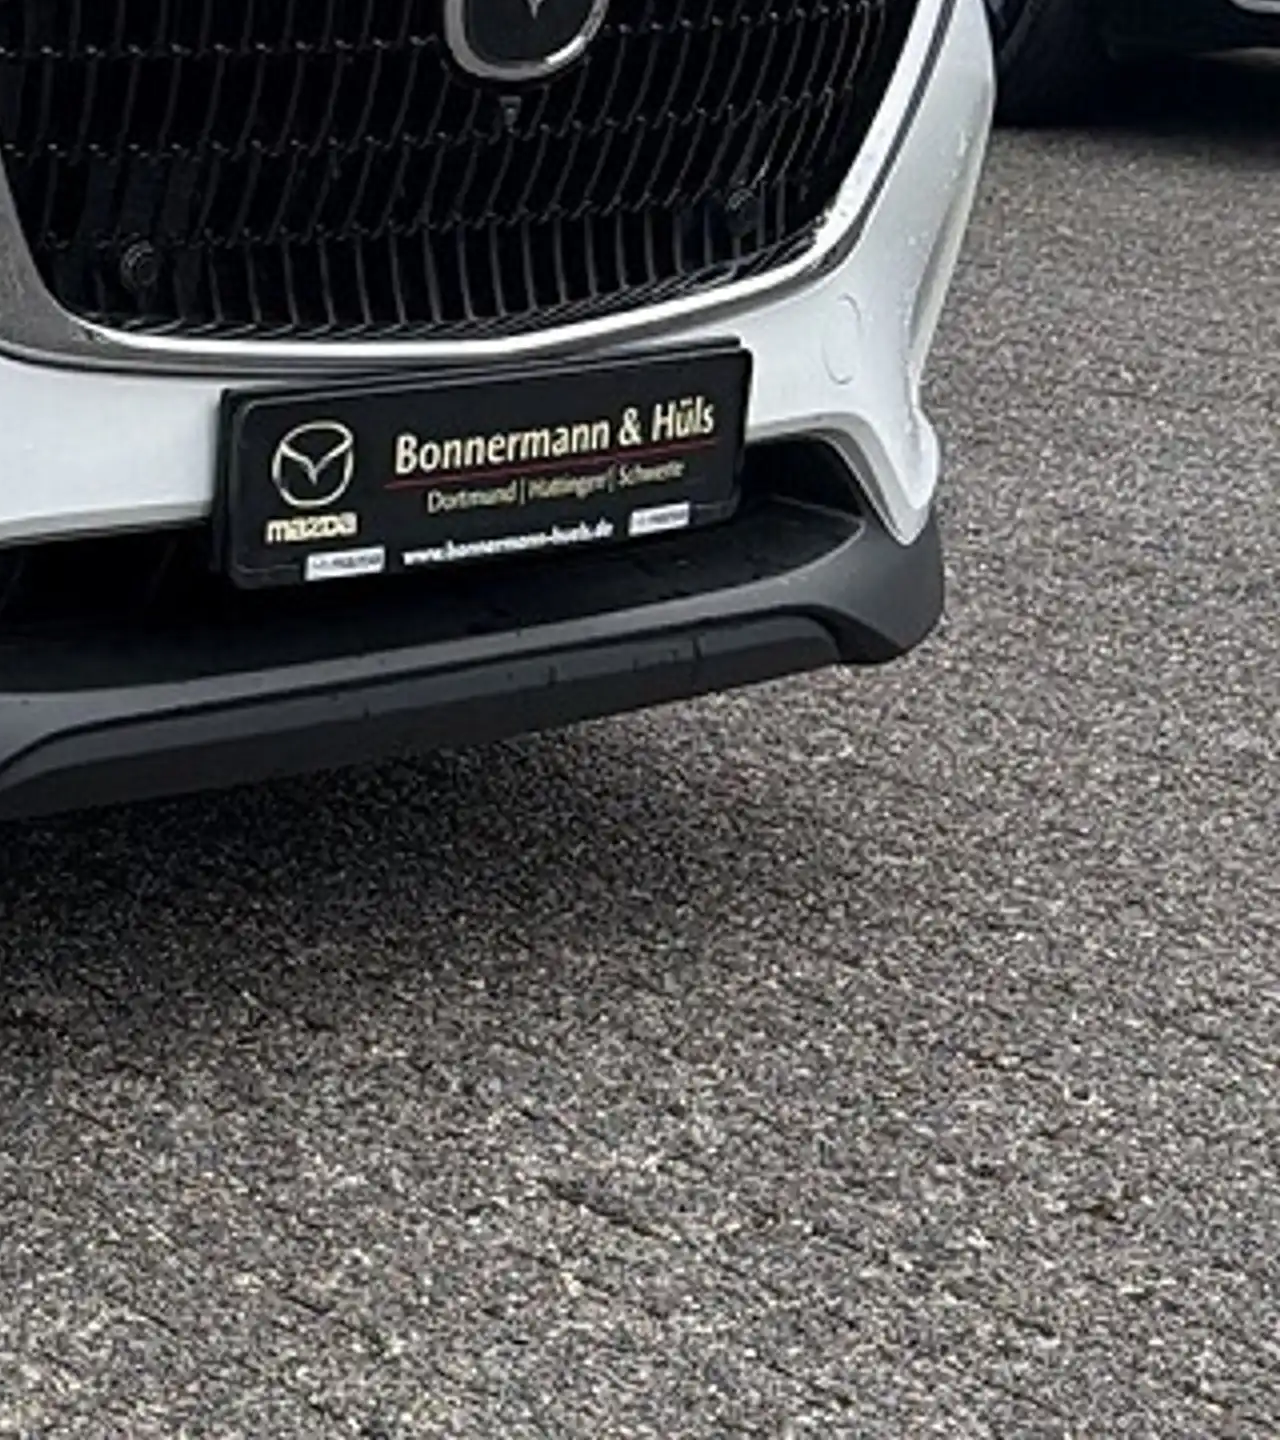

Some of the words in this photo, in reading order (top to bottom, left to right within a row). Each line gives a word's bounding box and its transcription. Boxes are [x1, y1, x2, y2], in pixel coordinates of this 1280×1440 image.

[395, 419, 611, 475] Bonnermann
[618, 408, 642, 447] &
[651, 395, 715, 443] Hüls
[426, 479, 518, 513] Dortmund
[266, 512, 358, 545] mazda
